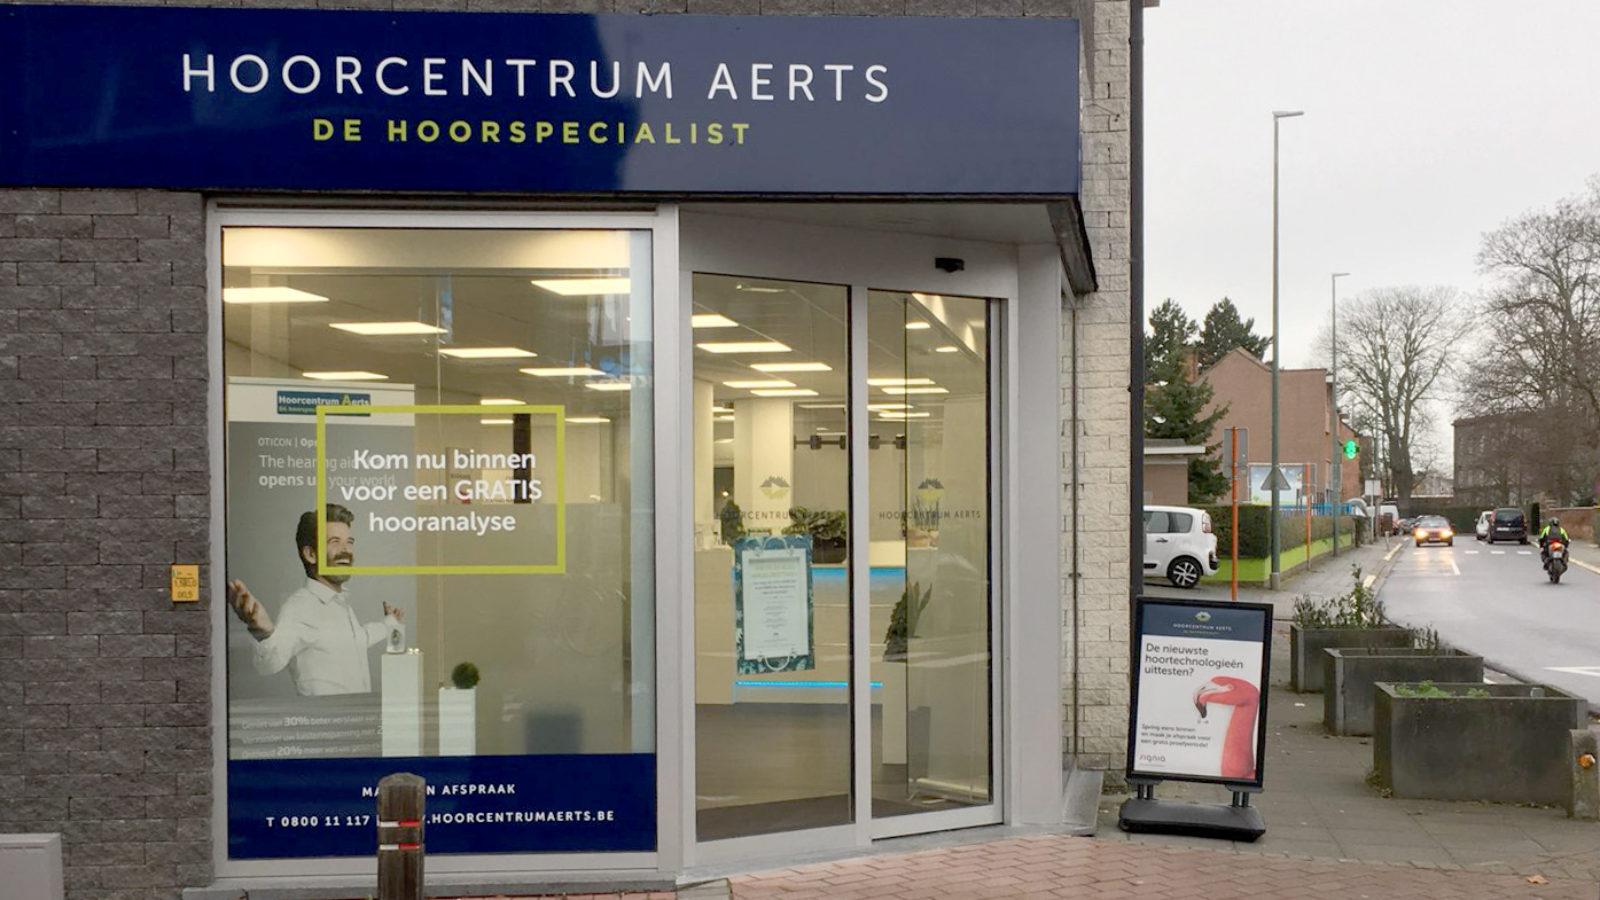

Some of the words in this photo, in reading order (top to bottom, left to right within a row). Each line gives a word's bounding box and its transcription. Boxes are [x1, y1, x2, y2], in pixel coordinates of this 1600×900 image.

[182, 53, 673, 100] HOORCENTRUM
[707, 62, 889, 103] AERTS
[313, 118, 362, 142] DE
[387, 119, 750, 145] HOORSPECIALIST
[278, 395, 340, 406] Hoorcentrum
[257, 436, 293, 448] OTICON
[258, 454, 288, 469] The
[352, 449, 409, 470] Kom
[416, 453, 446, 470] nu
[453, 449, 537, 470] binnen
[258, 474, 304, 489] opens
[327, 475, 356, 489] your
[340, 483, 398, 501] voor
[403, 483, 447, 501] een
[454, 479, 543, 501] GRATIS
[368, 511, 517, 536] hooranalyse
[1146, 643, 1160, 653] De
[1162, 644, 1209, 655] nieuwste
[1145, 654, 1244, 670] hoortechnologieën
[1144, 667, 1195, 677] uittesten?
[442, 784, 516, 796] AFSPRAAK
[265, 816, 275, 828] T
[281, 815, 319, 827] 0800
[325, 815, 340, 827] 11
[346, 815, 370, 827] 117
